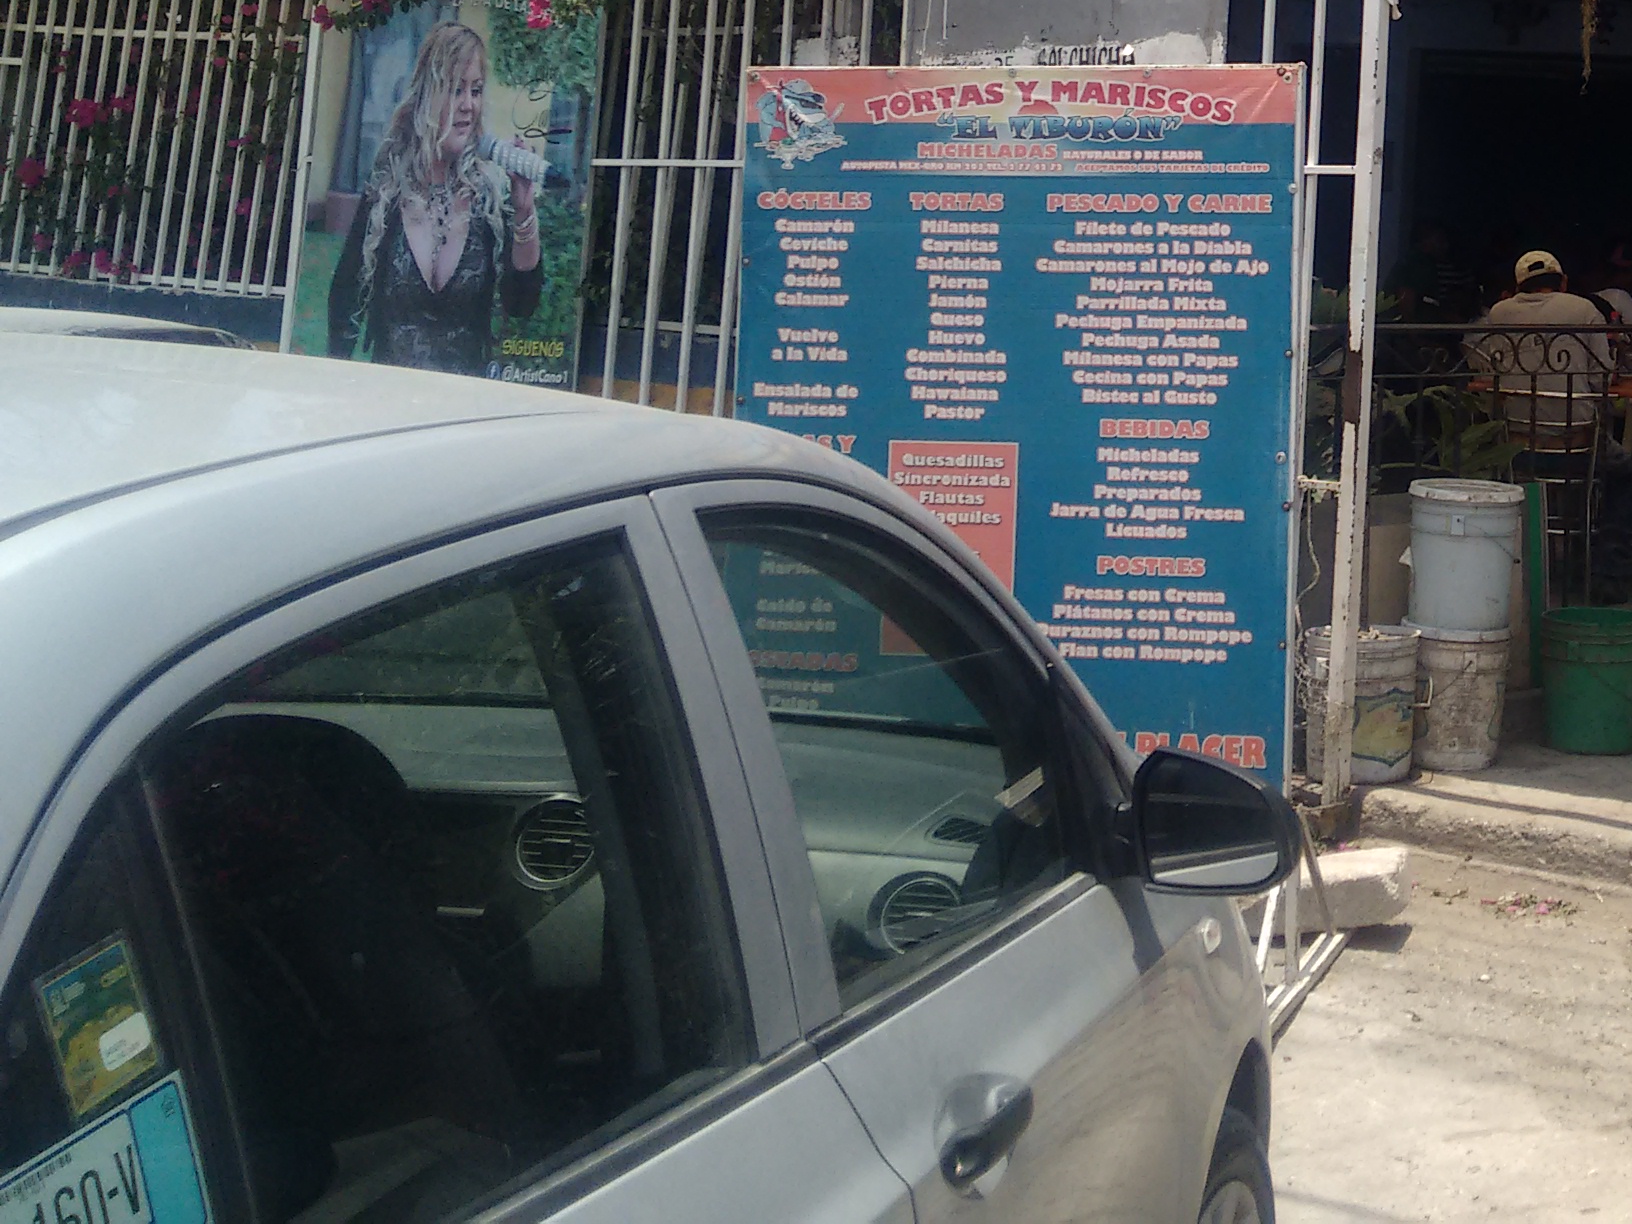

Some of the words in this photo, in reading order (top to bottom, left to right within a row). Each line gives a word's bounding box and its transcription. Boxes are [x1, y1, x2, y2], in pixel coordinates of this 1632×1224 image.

[865, 81, 1003, 124] TORTAS
[1014, 80, 1039, 104] Y
[1050, 78, 1236, 125] MARISCOS
[917, 142, 1057, 159] MICHELADAS
[1161, 150, 1203, 161] SABOR
[1137, 162, 1158, 173] SUS
[1158, 162, 1210, 173] TARJETAS
[1210, 163, 1226, 173] DE
[1226, 161, 1271, 173] CRÉDITO
[757, 188, 872, 211] CÓCTELES
[910, 192, 1004, 211] TORTAS
[1046, 193, 1159, 213] PESCADO
[1163, 193, 1186, 213] Y
[1187, 193, 1273, 213] CARNE
[774, 218, 855, 233] Camarón
[920, 219, 1000, 235] Milanesa
[1074, 220, 1127, 236] Filete
[1130, 221, 1153, 236] de
[1156, 221, 1231, 237] Pescado
[779, 236, 849, 252] Ceviche
[921, 238, 998, 254] Carnitas
[1053, 239, 1154, 255] Camarones
[1157, 242, 1169, 255] a
[1172, 240, 1190, 255] la
[1193, 240, 1252, 256] Diabla
[787, 254, 840, 272] Pulpo
[915, 255, 1002, 272] Salchicha
[1035, 257, 1136, 273] Camarones
[1139, 258, 1157, 274] al
[1160, 258, 1206, 275] Mojo
[1208, 259, 1233, 274] de
[1234, 259, 1270, 277] Ajo
[783, 273, 841, 289] Ostión
[928, 274, 989, 290] Pierna
[1090, 276, 1164, 293] Mojarra
[1167, 277, 1213, 293] Frita
[774, 291, 849, 307] Calamar
[928, 293, 987, 309] Jamón
[1076, 294, 1170, 311] Parrillada
[1173, 295, 1227, 311] Mixta
[929, 311, 984, 328] Queso
[1055, 313, 1133, 331] Pechuga
[1135, 314, 1248, 332] Empanizada
[777, 327, 839, 344] Vuelve
[927, 330, 986, 345] Huevo
[1081, 332, 1159, 350] Pechuga
[1161, 333, 1220, 349] Asada
[771, 347, 783, 361] a
[786, 346, 804, 361] la
[806, 346, 849, 362] Vida
[905, 348, 1007, 365] Combinada
[1062, 350, 1143, 367] Milanesa
[1146, 354, 1179, 367] con
[1182, 352, 1239, 370] Papas
[904, 366, 1008, 384] Choriqueso
[1072, 370, 1133, 385] Cecina
[1136, 372, 1170, 386] con
[1172, 371, 1228, 388] Papas
[753, 381, 832, 398] Ensalada
[835, 384, 859, 399] de
[910, 384, 999, 402] Hawaiana
[1081, 388, 1139, 404] Bistec
[1141, 389, 1160, 404] al
[1163, 389, 1218, 405] Gusto
[767, 401, 847, 417] Mariscos
[923, 403, 985, 421] Pastor
[1099, 418, 1210, 439] BEBIDAS
[902, 453, 1004, 469] Quesadillas
[1096, 446, 1200, 464] Micheladas
[892, 471, 1011, 487] Sincronizada
[1106, 465, 1190, 483] Refresco
[919, 490, 985, 506] Flautas
[1093, 484, 1202, 502] Preparados
[932, 510, 1002, 526] aquiles
[1049, 502, 1100, 519] Jarra
[1103, 503, 1127, 519] de
[1129, 504, 1180, 521] Agua
[1183, 505, 1245, 522] Fresca
[1105, 522, 1188, 539] Licuados
[1096, 555, 1206, 577] POSTRES
[1063, 584, 1124, 602] Fresas
[1126, 588, 1160, 603] con
[1164, 588, 1226, 604] Crema
[1052, 604, 1133, 621] Plátanos
[1136, 608, 1171, 622] con
[1174, 607, 1236, 624] Crema
[1126, 627, 1160, 641] con
[1163, 626, 1253, 645] Rompope
[1058, 642, 1099, 658] Flan
[1101, 645, 1135, 659] con
[1138, 644, 1227, 663] Rompope
